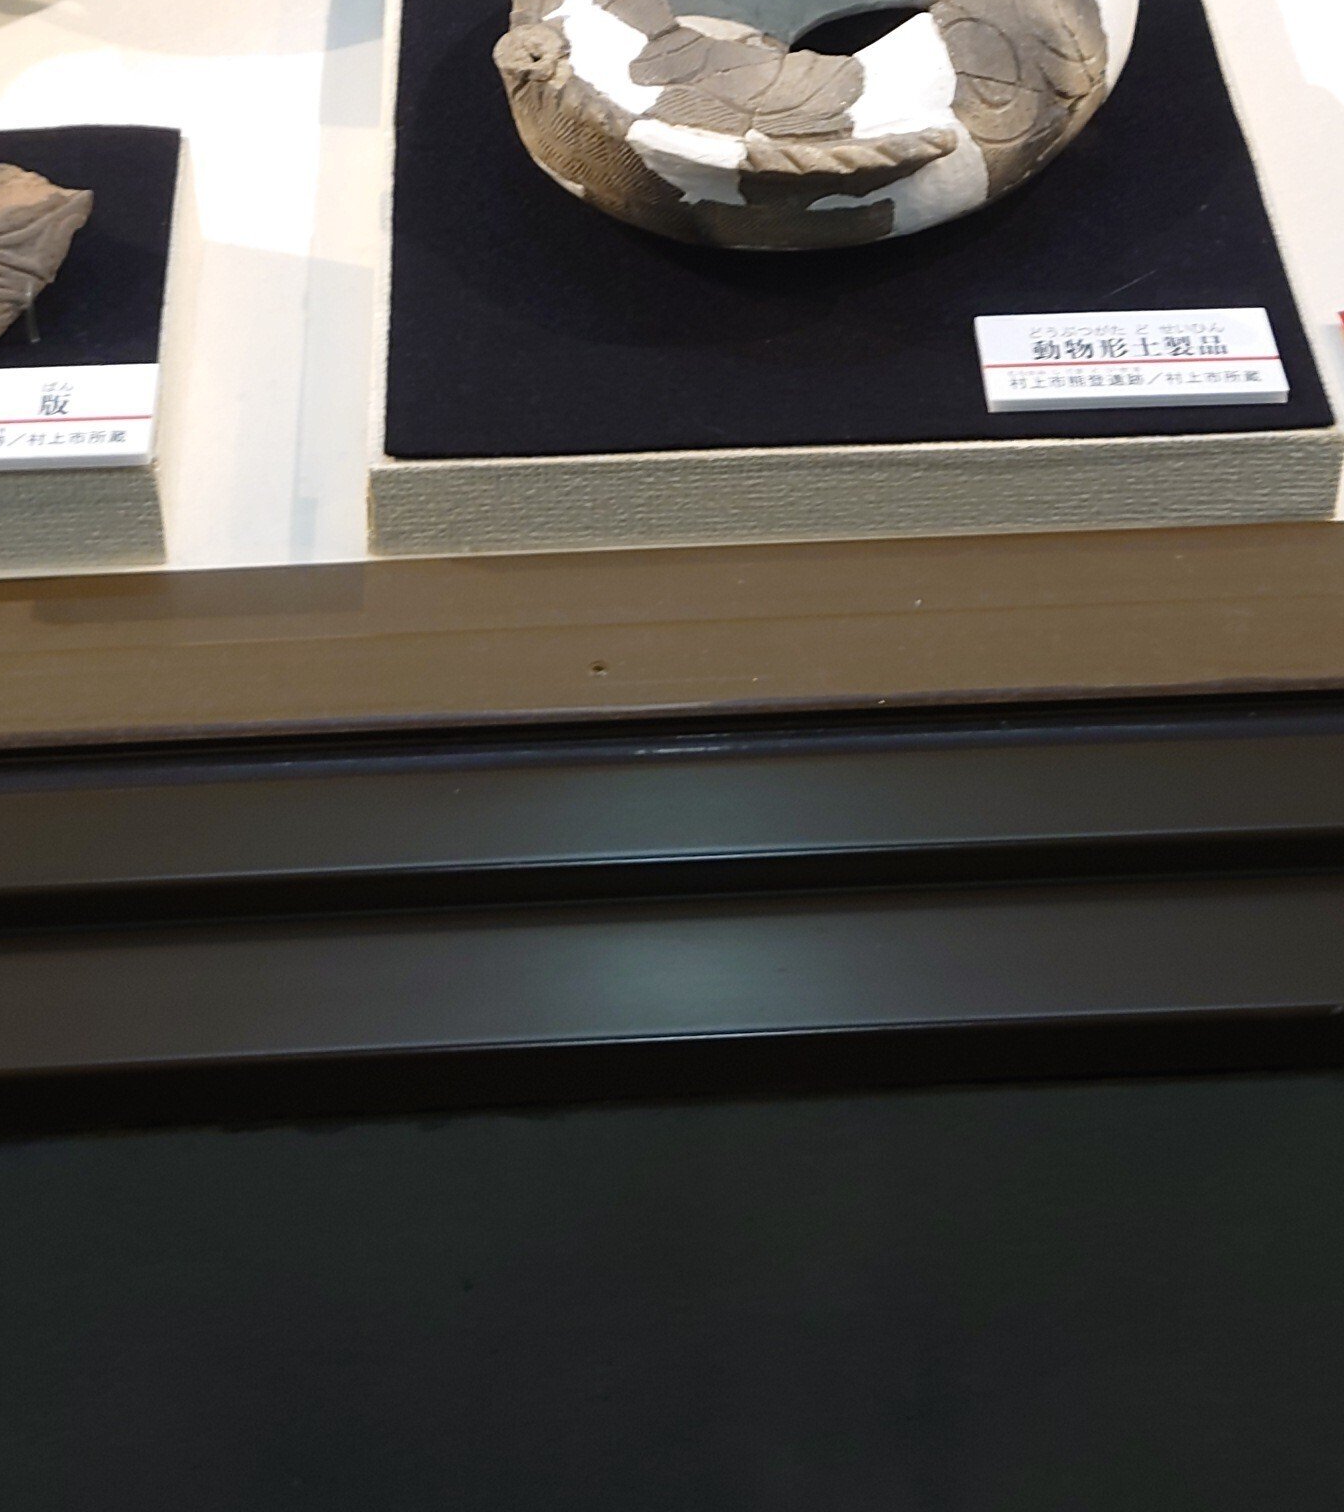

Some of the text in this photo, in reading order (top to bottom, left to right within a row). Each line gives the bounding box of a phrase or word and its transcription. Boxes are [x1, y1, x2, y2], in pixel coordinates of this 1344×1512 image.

[1032, 335, 1229, 361] 動物形土製品
